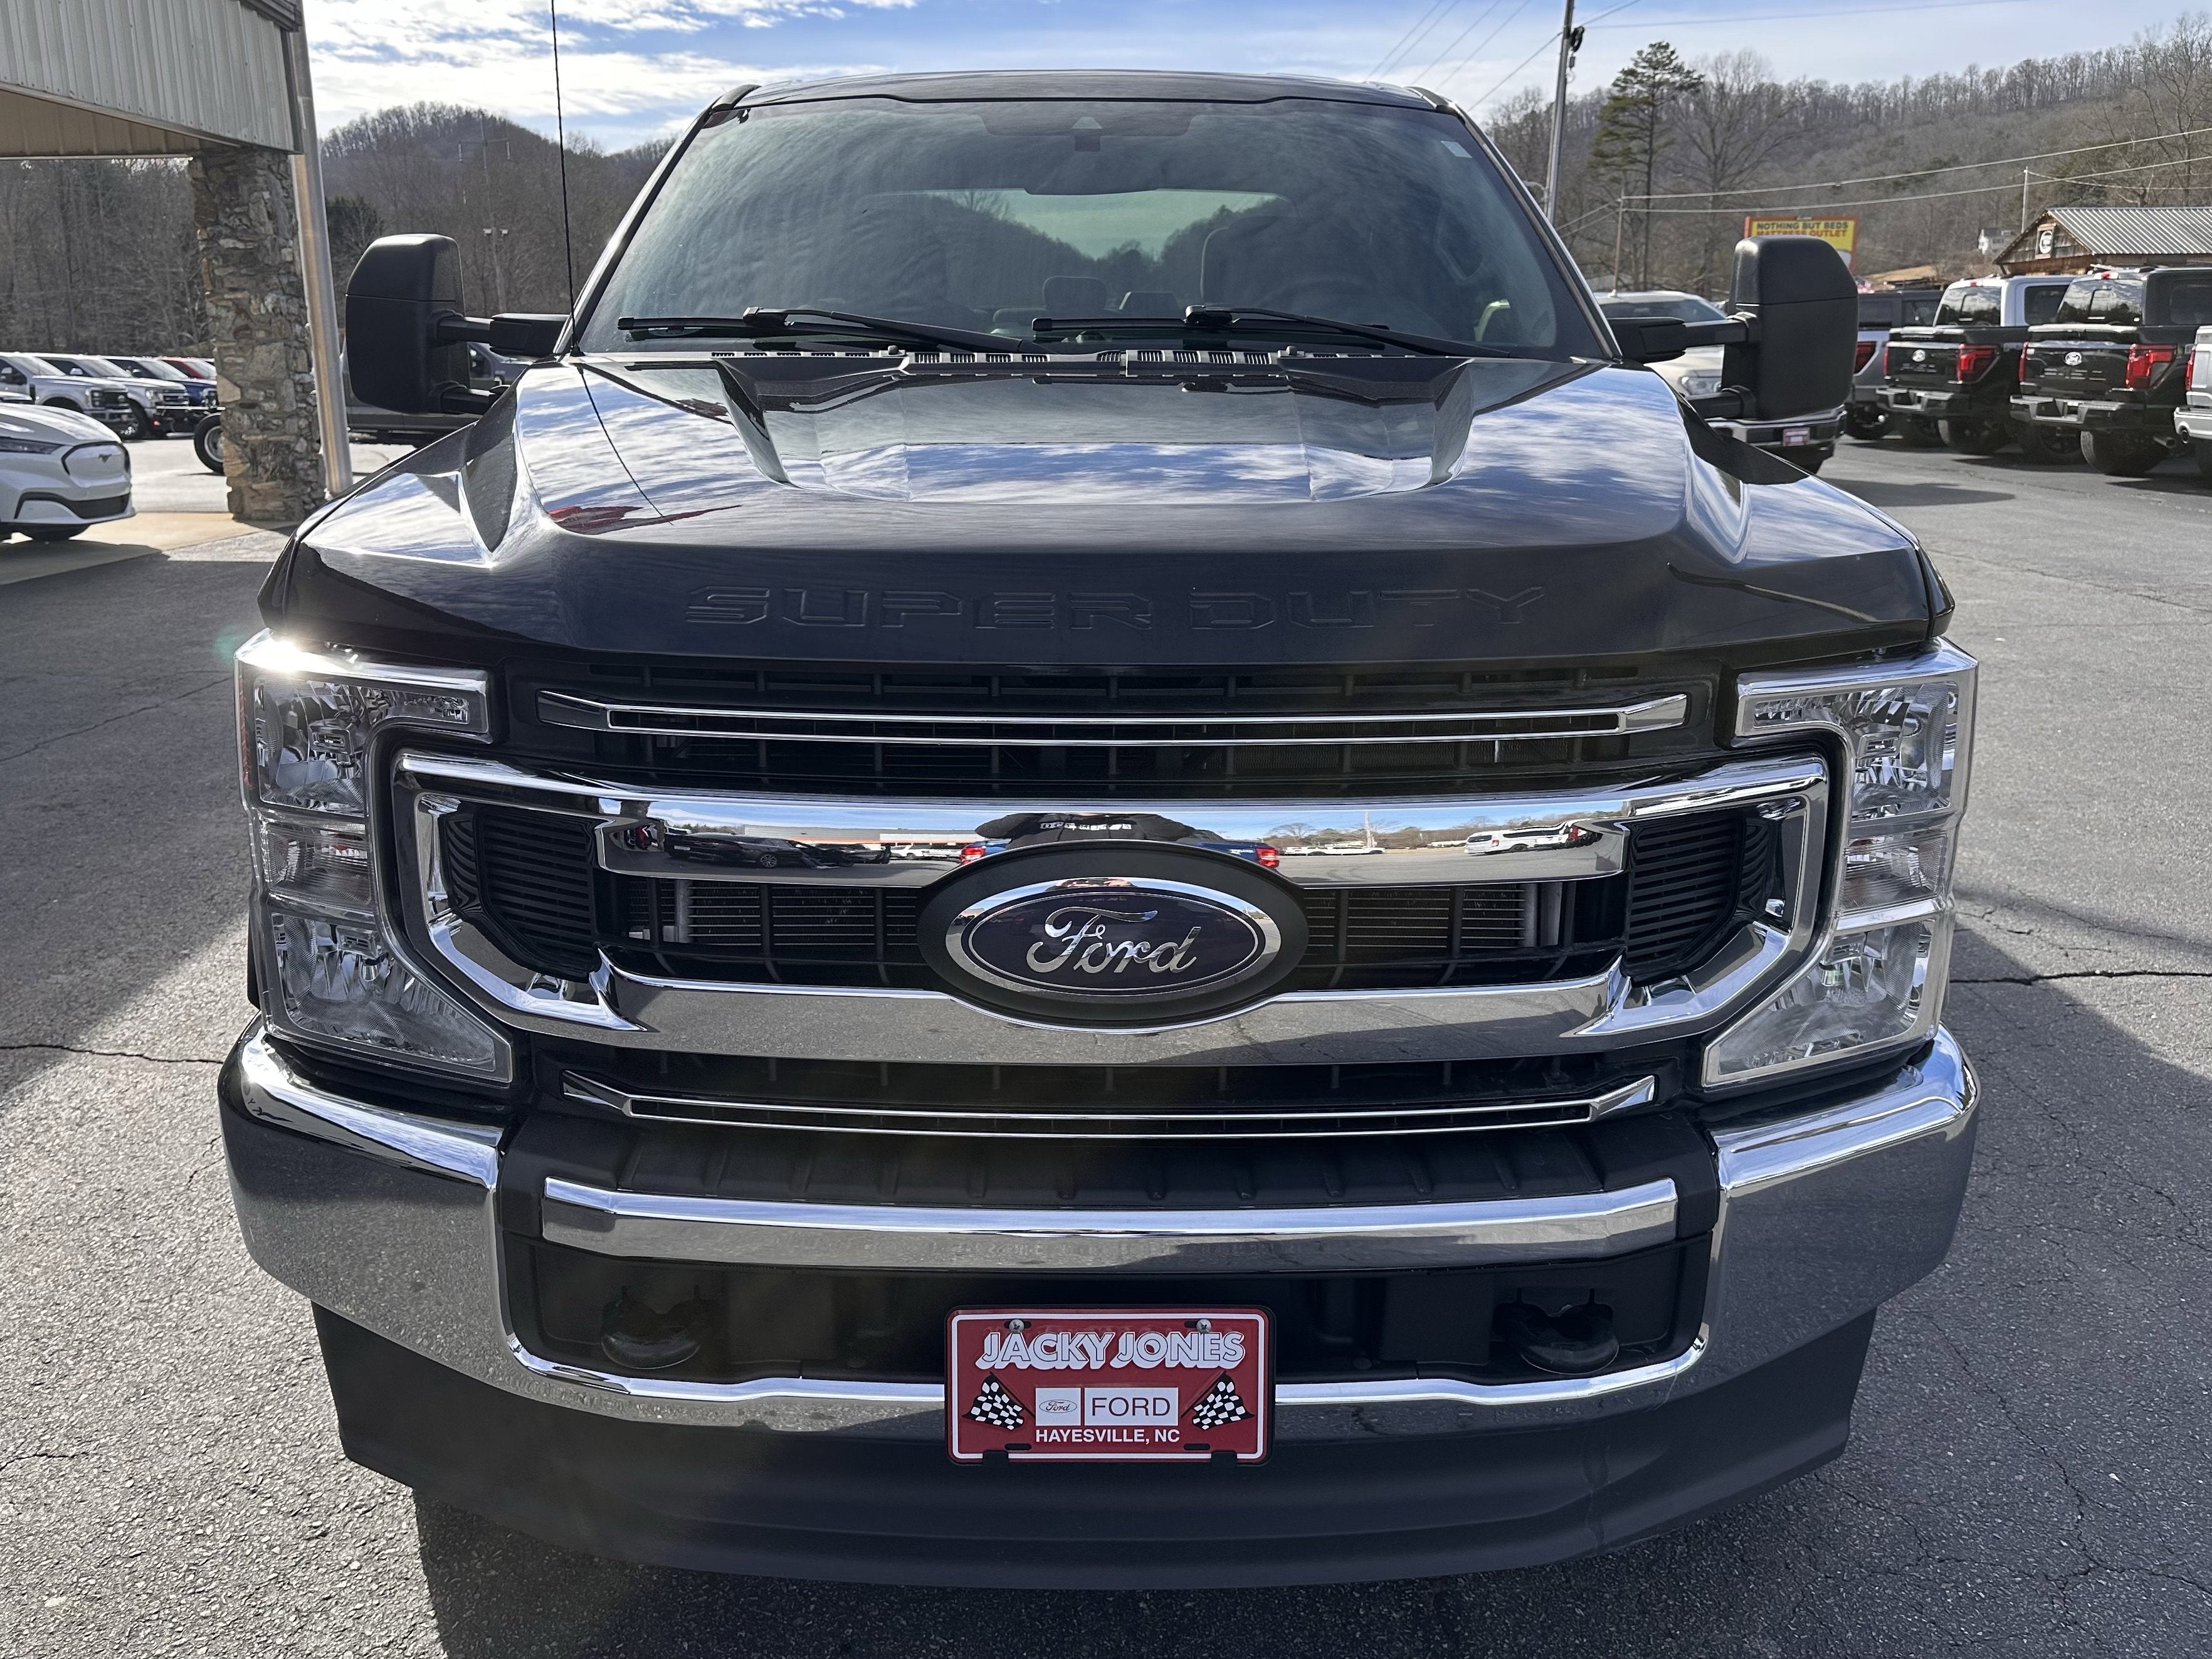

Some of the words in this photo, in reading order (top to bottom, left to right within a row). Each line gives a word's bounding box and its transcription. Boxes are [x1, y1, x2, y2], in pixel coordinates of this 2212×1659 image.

[685, 585, 1154, 631] SUPER
[1188, 586, 1546, 629] DUTY
[1025, 906, 1202, 974] Ford
[976, 1330, 1116, 1370] JACKY
[1109, 1330, 1246, 1370] JONES
[1045, 1401, 1071, 1412] Ford
[1091, 1396, 1171, 1417] FORD
[1035, 1428, 1150, 1445] HAYESVILLE,
[1154, 1428, 1181, 1443] NC
